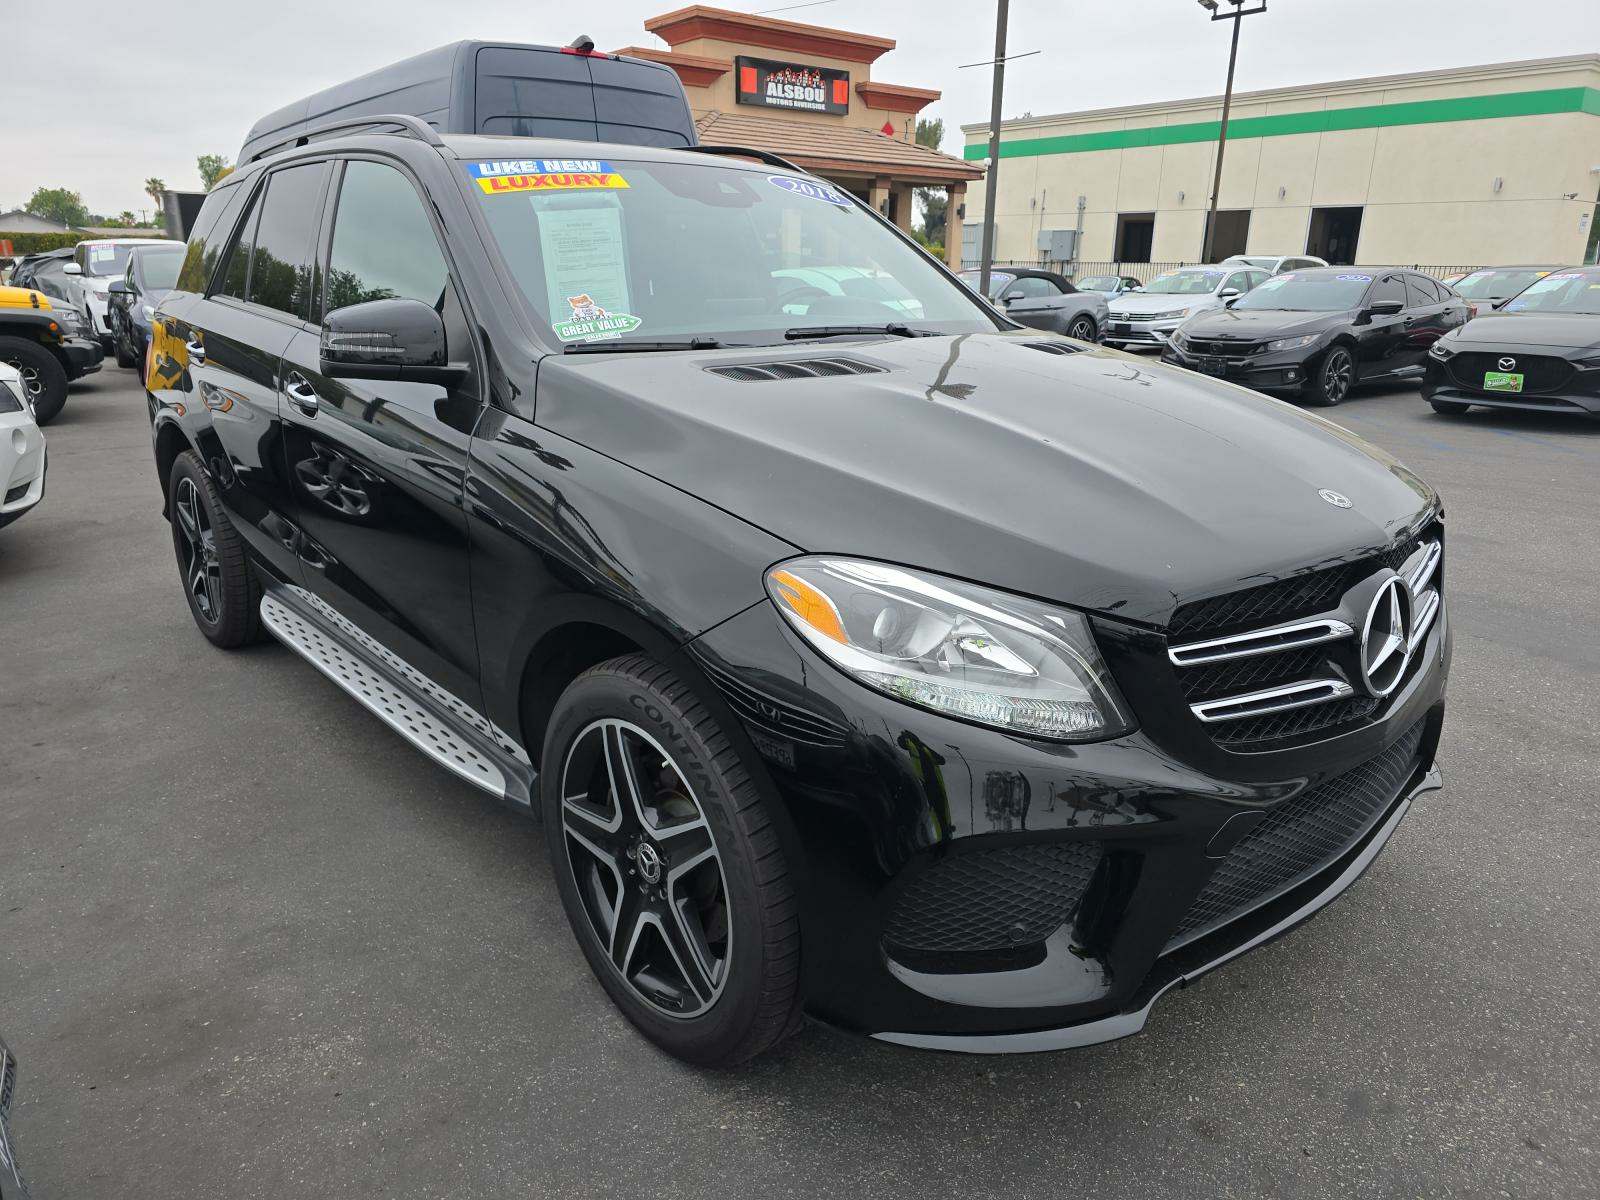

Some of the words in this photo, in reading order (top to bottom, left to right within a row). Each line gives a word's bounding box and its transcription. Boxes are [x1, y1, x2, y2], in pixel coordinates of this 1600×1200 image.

[767, 82, 825, 102] ALSBOU
[766, 97, 793, 106] MOTORS
[794, 100, 826, 110] RIVERSIDE
[479, 161, 538, 175] LIKE
[543, 160, 600, 174] NEW
[490, 174, 608, 190] LUXURY
[787, 180, 841, 203] 2018
[562, 322, 595, 336] GREAT
[597, 317, 630, 331] VALUE
